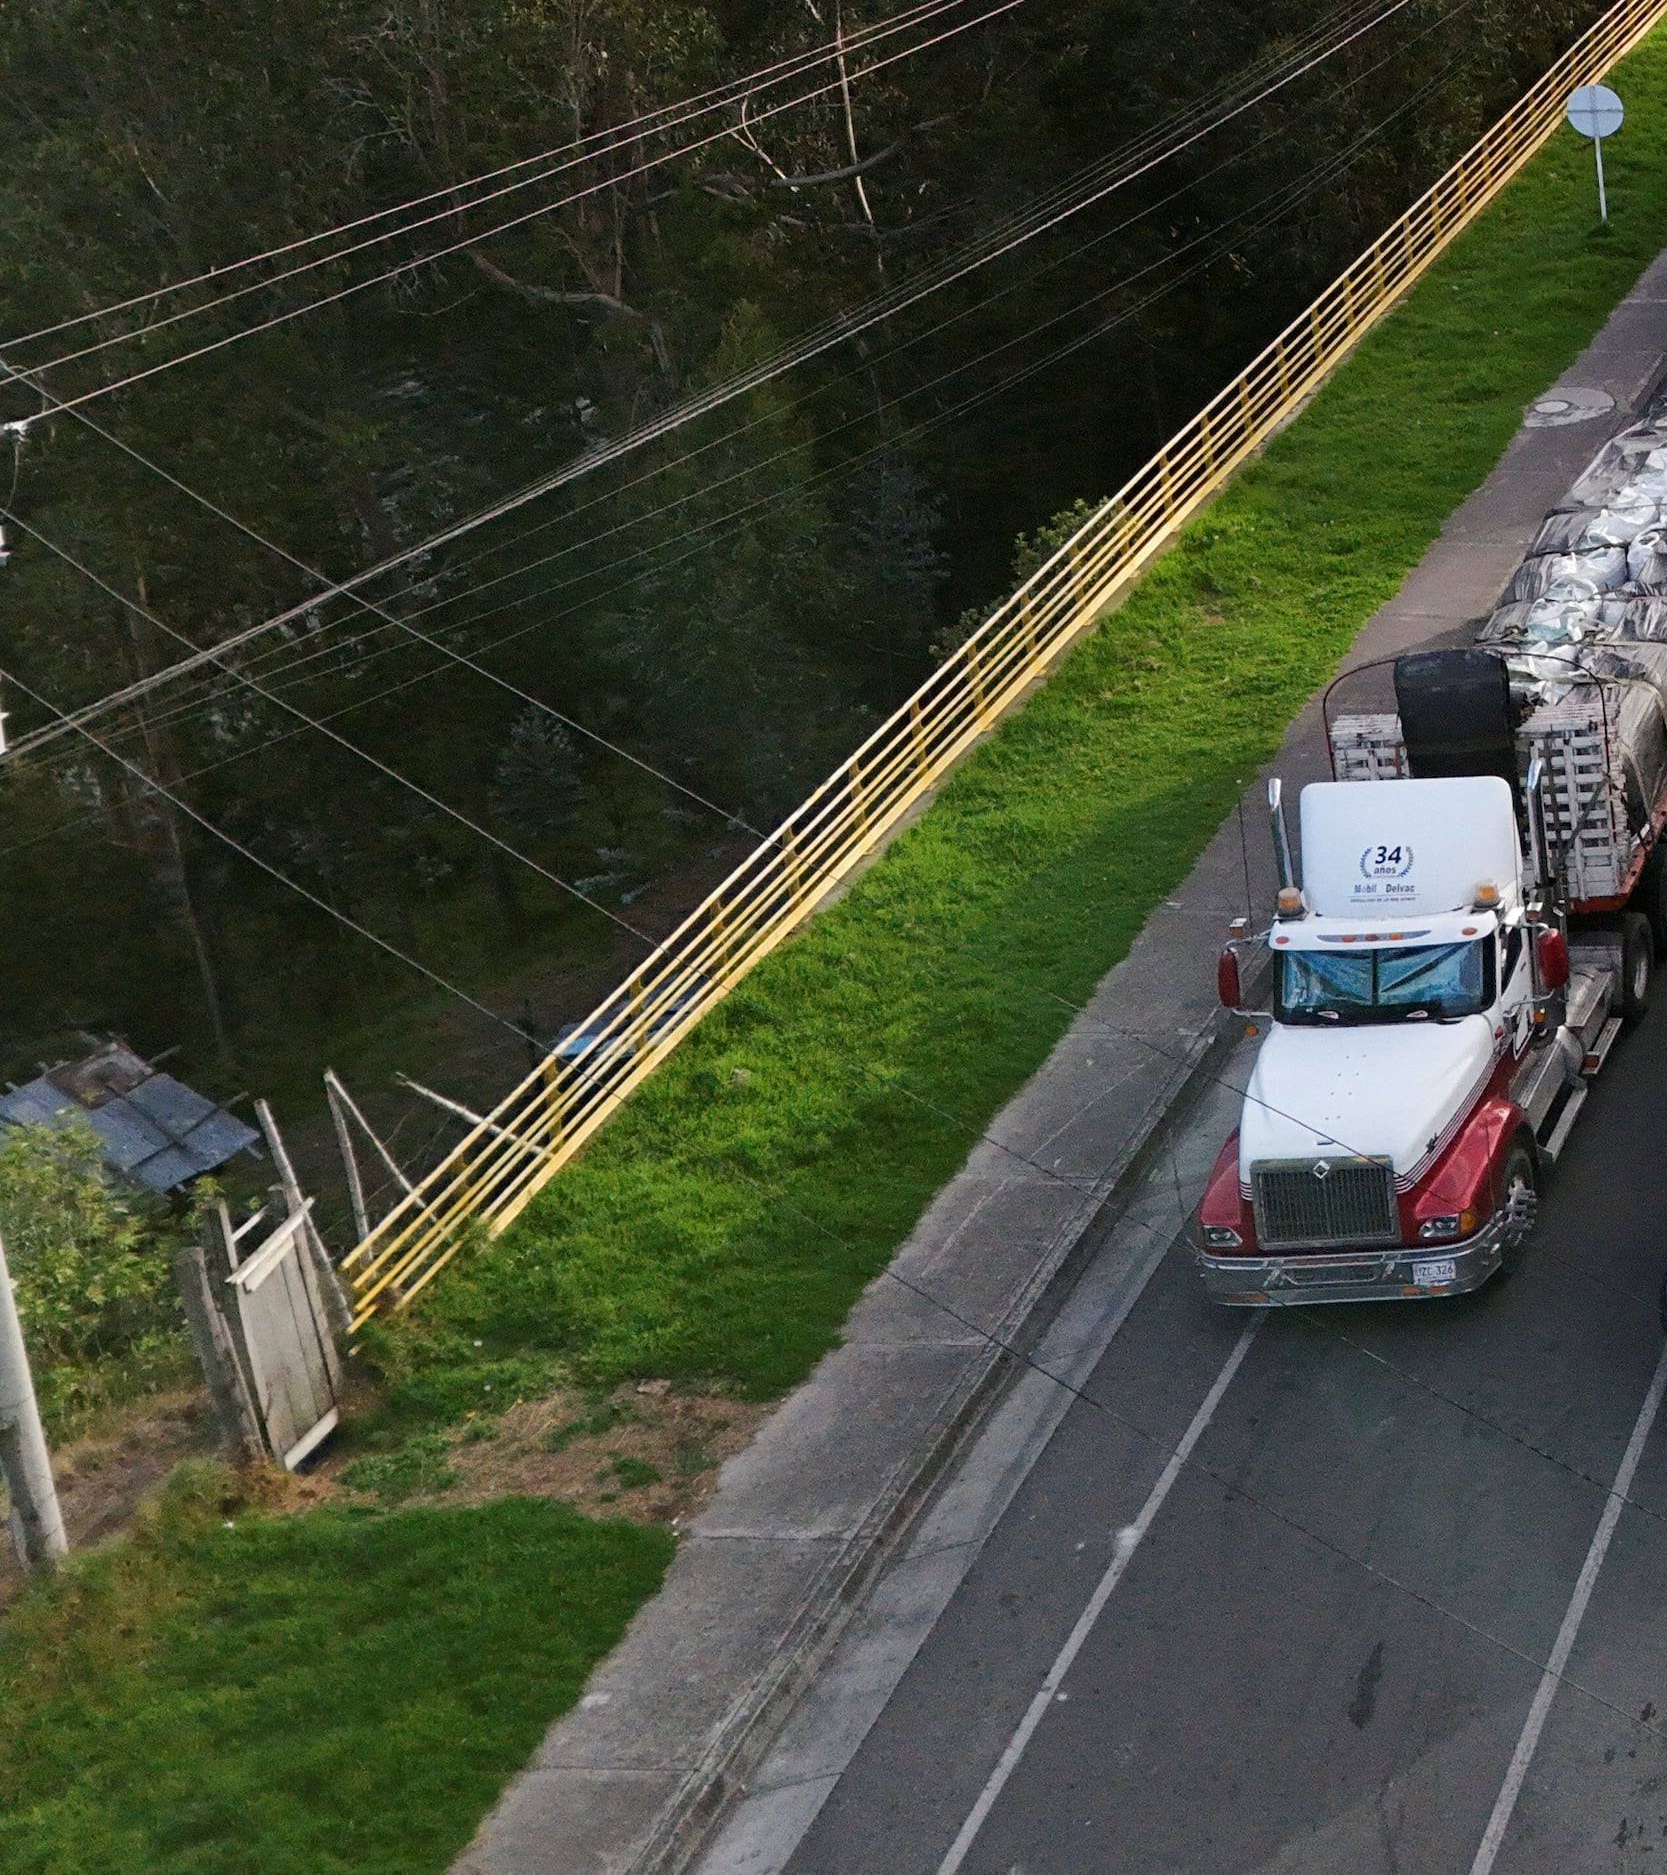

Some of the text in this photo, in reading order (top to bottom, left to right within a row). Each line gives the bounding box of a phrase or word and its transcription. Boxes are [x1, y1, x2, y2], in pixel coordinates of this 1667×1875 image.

[1375, 846, 1402, 864] 34
[1354, 883, 1415, 893] Mobil Delvac
